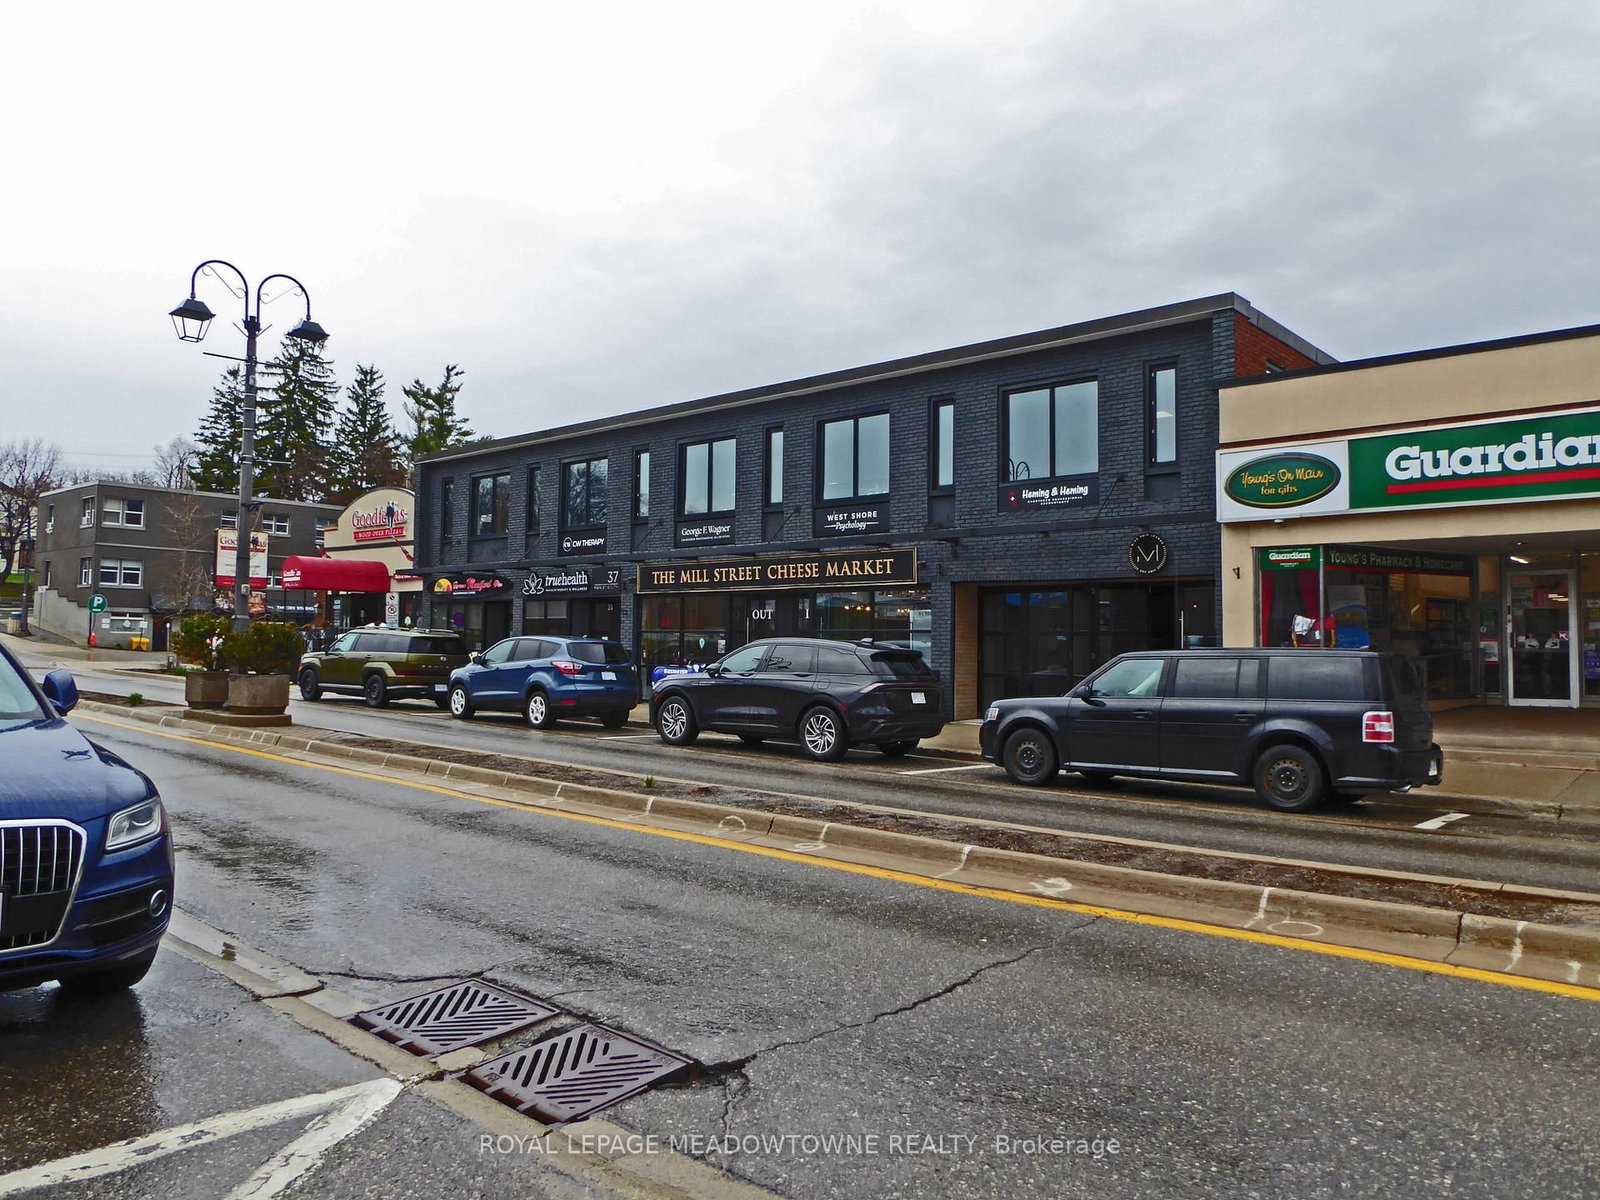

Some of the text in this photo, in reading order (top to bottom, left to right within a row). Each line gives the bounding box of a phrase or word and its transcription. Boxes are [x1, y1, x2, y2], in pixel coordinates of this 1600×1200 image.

[1385, 432, 1600, 480] Guardia
[1241, 471, 1275, 488] Young's
[1296, 468, 1324, 481] Main
[1022, 485, 1089, 499] Heming & Heming
[827, 510, 878, 521] WEST SHORE
[681, 527, 702, 537] George
[708, 525, 731, 535] Wagner
[835, 520, 867, 532] Psychology
[1268, 552, 1311, 560] Guardian
[607, 571, 619, 584] 37
[652, 558, 894, 585] THE MILL STREET CHEESE MARKET
[752, 609, 774, 620] OUT
